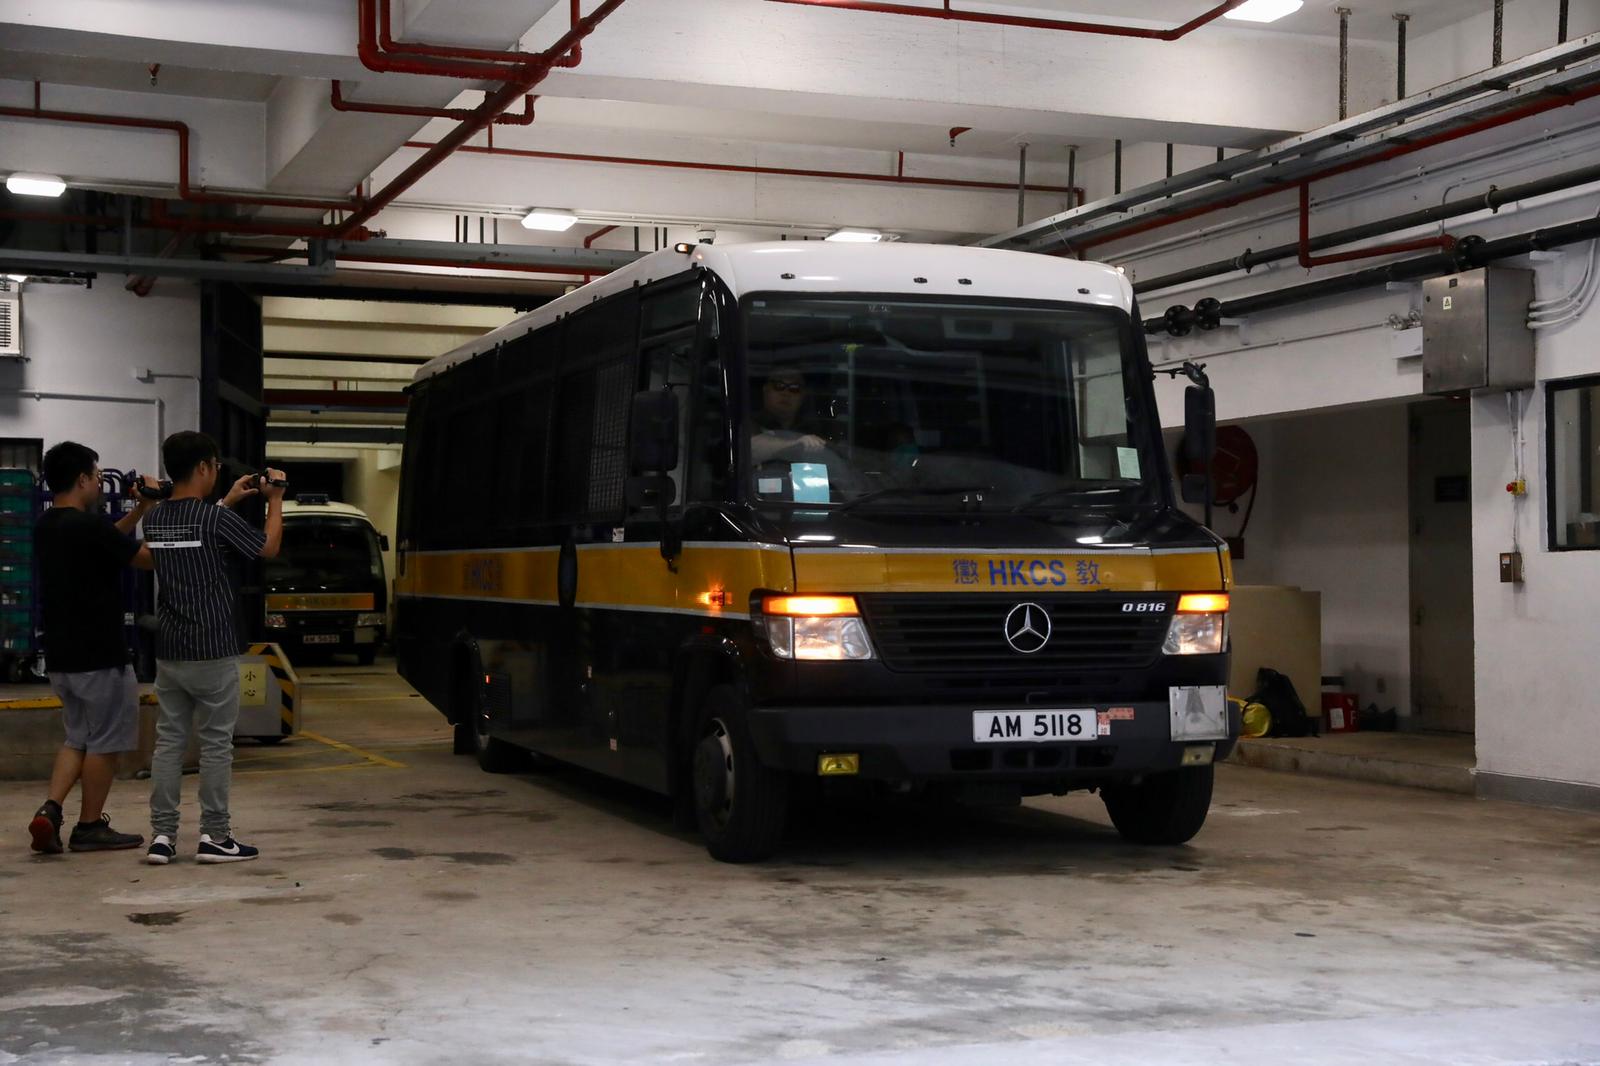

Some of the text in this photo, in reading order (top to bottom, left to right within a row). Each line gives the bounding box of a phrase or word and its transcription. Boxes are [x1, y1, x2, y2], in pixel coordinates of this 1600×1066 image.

[989, 560, 1066, 586] HKCS
[1136, 602, 1166, 612] 816
[244, 670, 256, 697] 小心
[989, 714, 1082, 737] AM 5118
